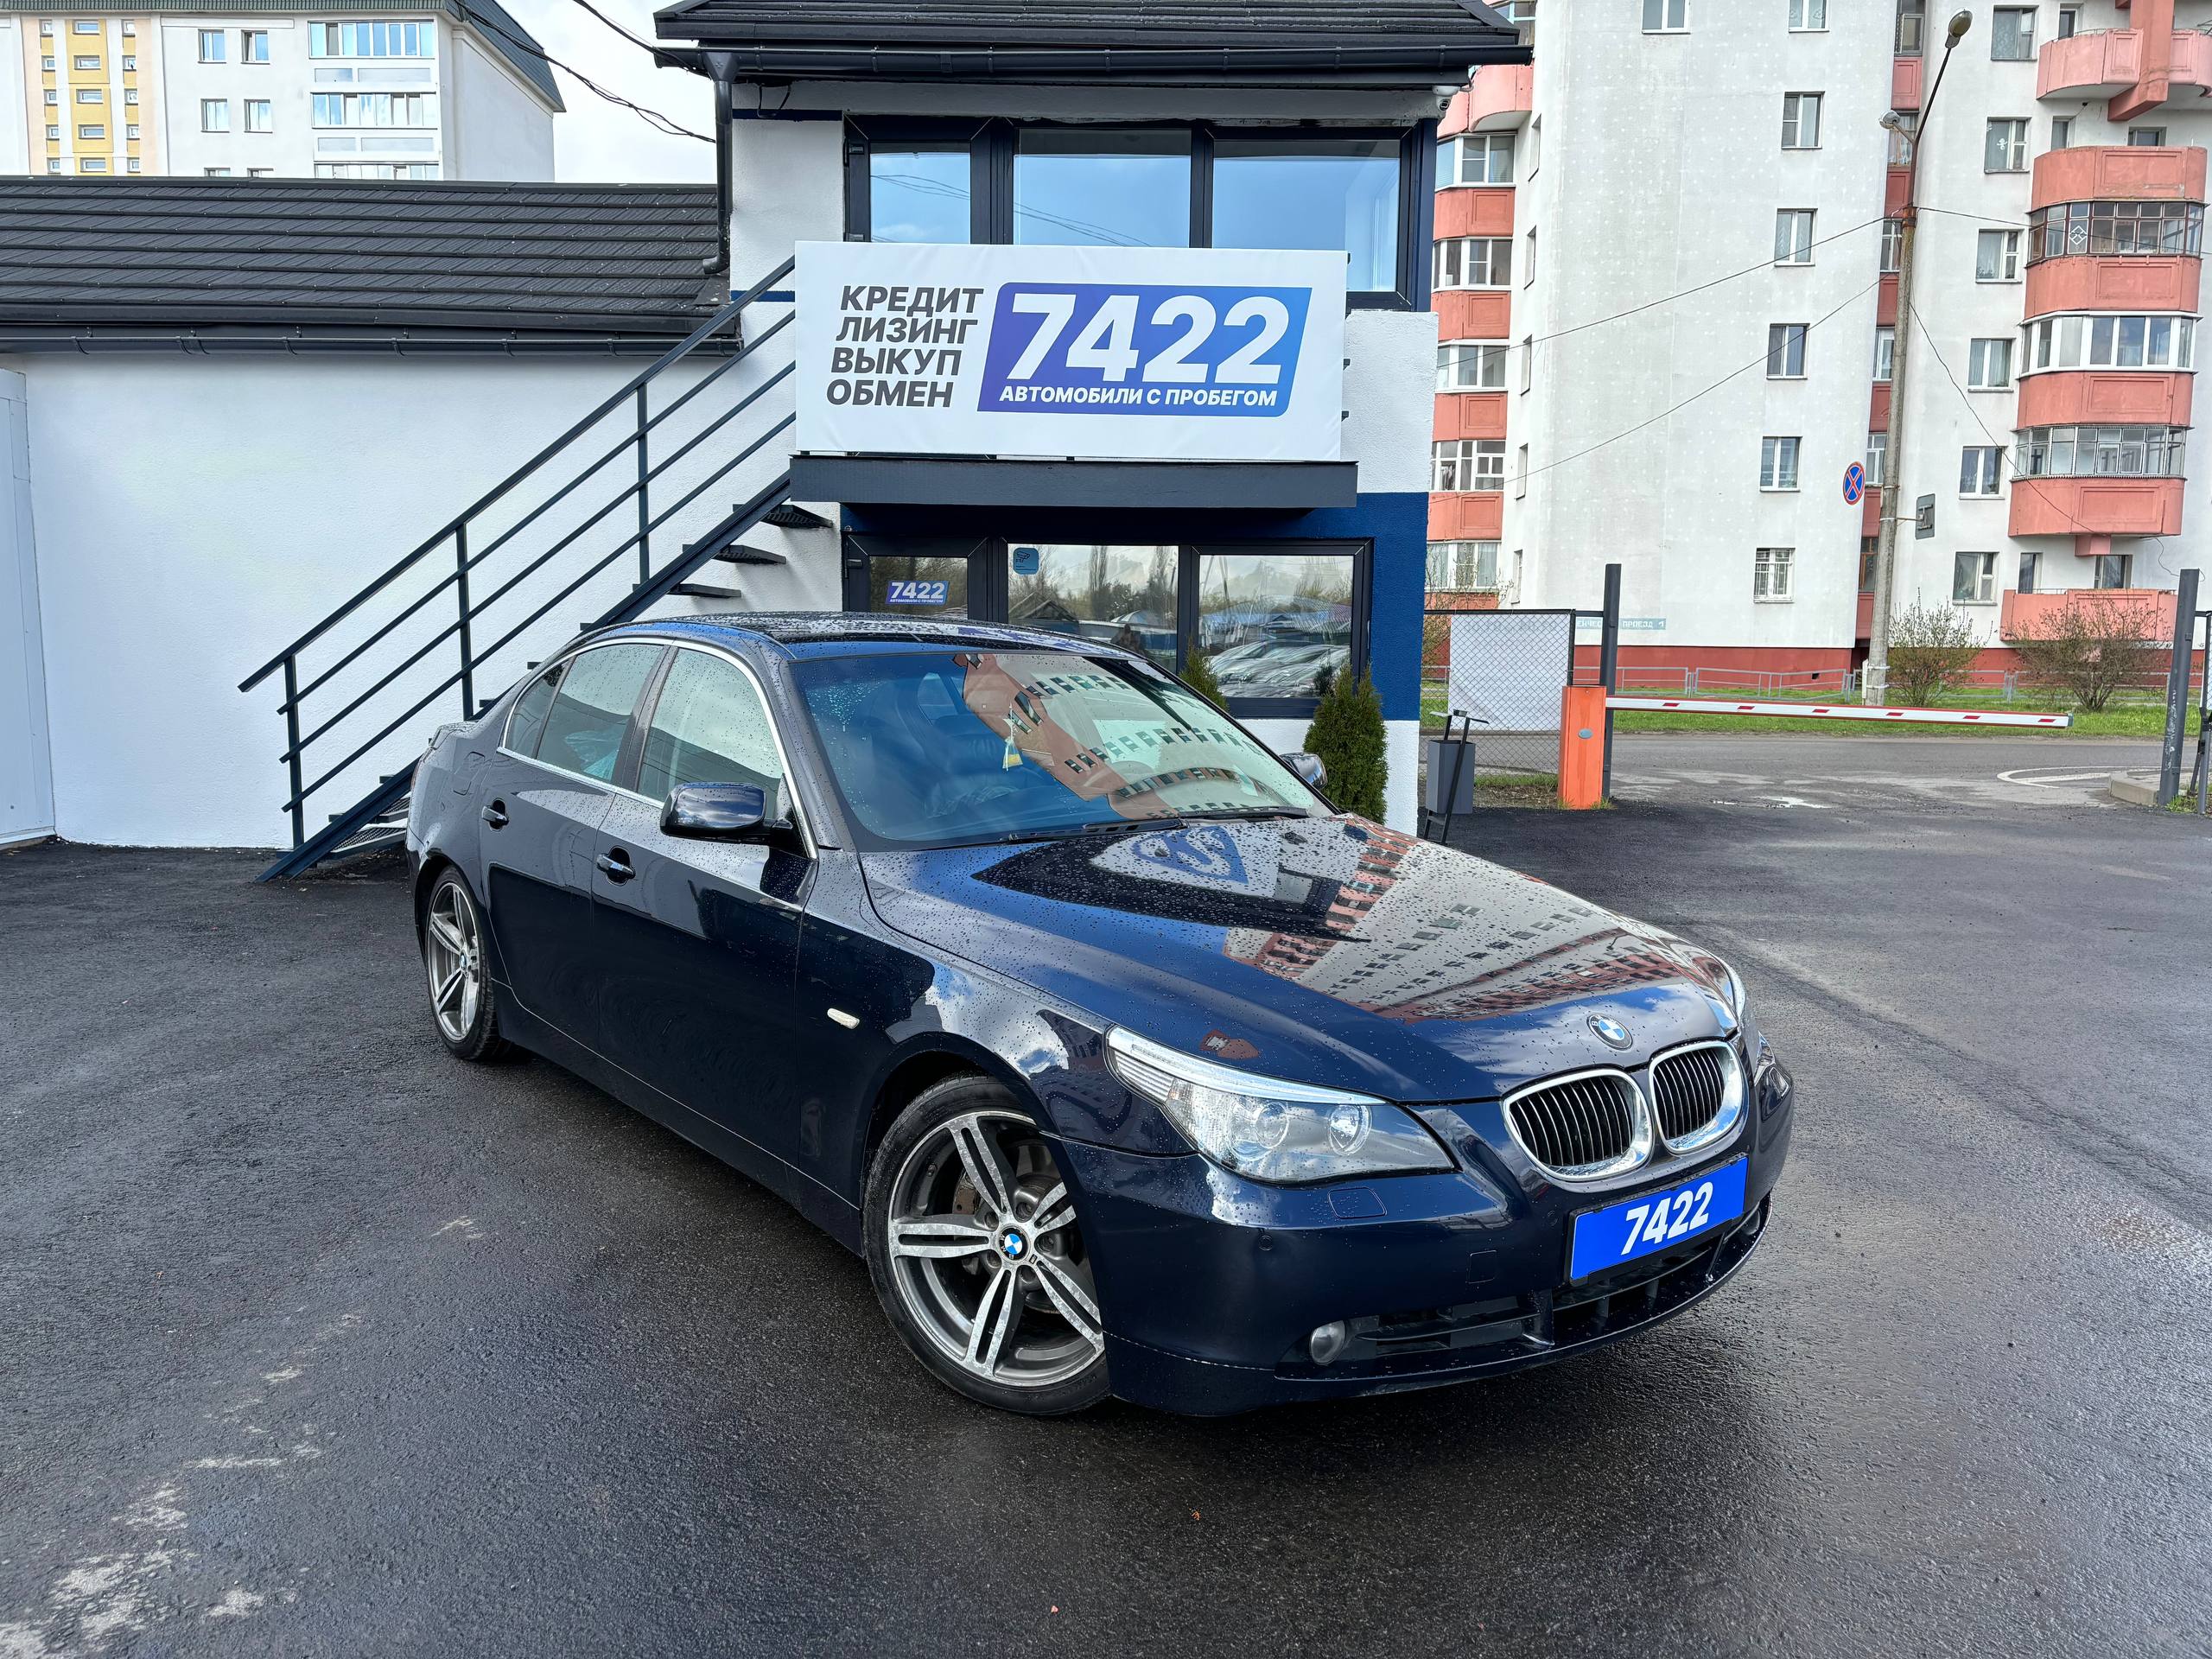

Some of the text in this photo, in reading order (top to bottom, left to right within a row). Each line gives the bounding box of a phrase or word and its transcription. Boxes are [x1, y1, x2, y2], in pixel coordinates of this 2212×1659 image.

[840, 285, 984, 317] КРЕДИТ
[835, 316, 978, 344] ЛИЗИНГ
[1006, 294, 1289, 385] 7422
[830, 346, 962, 376] ВЫКУП
[826, 378, 954, 407] ОБМЕН
[999, 385, 1277, 406] АВТОМОБИЛИ С ПРОБЕГОМ
[891, 582, 945, 599] 7422
[1621, 1181, 1713, 1255] 7422
